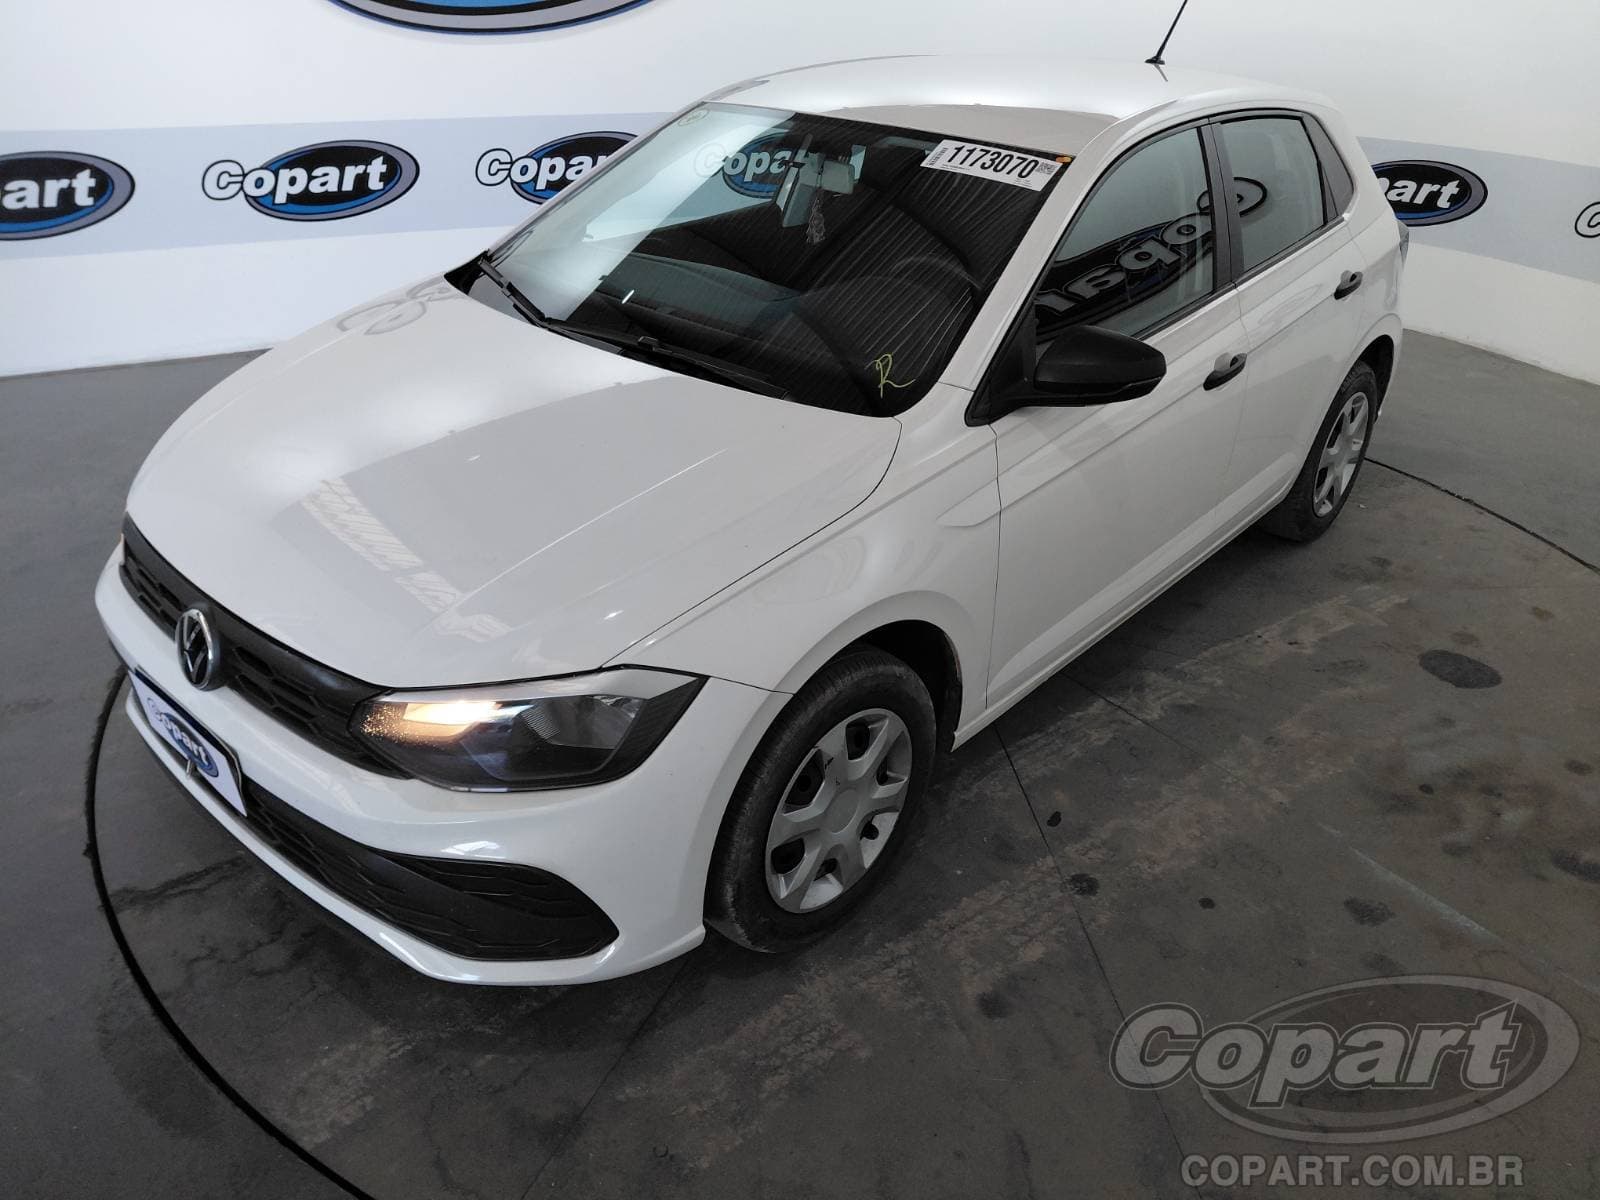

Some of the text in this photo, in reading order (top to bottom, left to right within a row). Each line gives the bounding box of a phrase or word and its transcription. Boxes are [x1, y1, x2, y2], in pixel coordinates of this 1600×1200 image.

[202, 160, 388, 204] Copart
[475, 148, 609, 190] Copa
[694, 142, 809, 182] Copa
[947, 145, 1040, 179] 1173070
[0, 169, 96, 210] art
